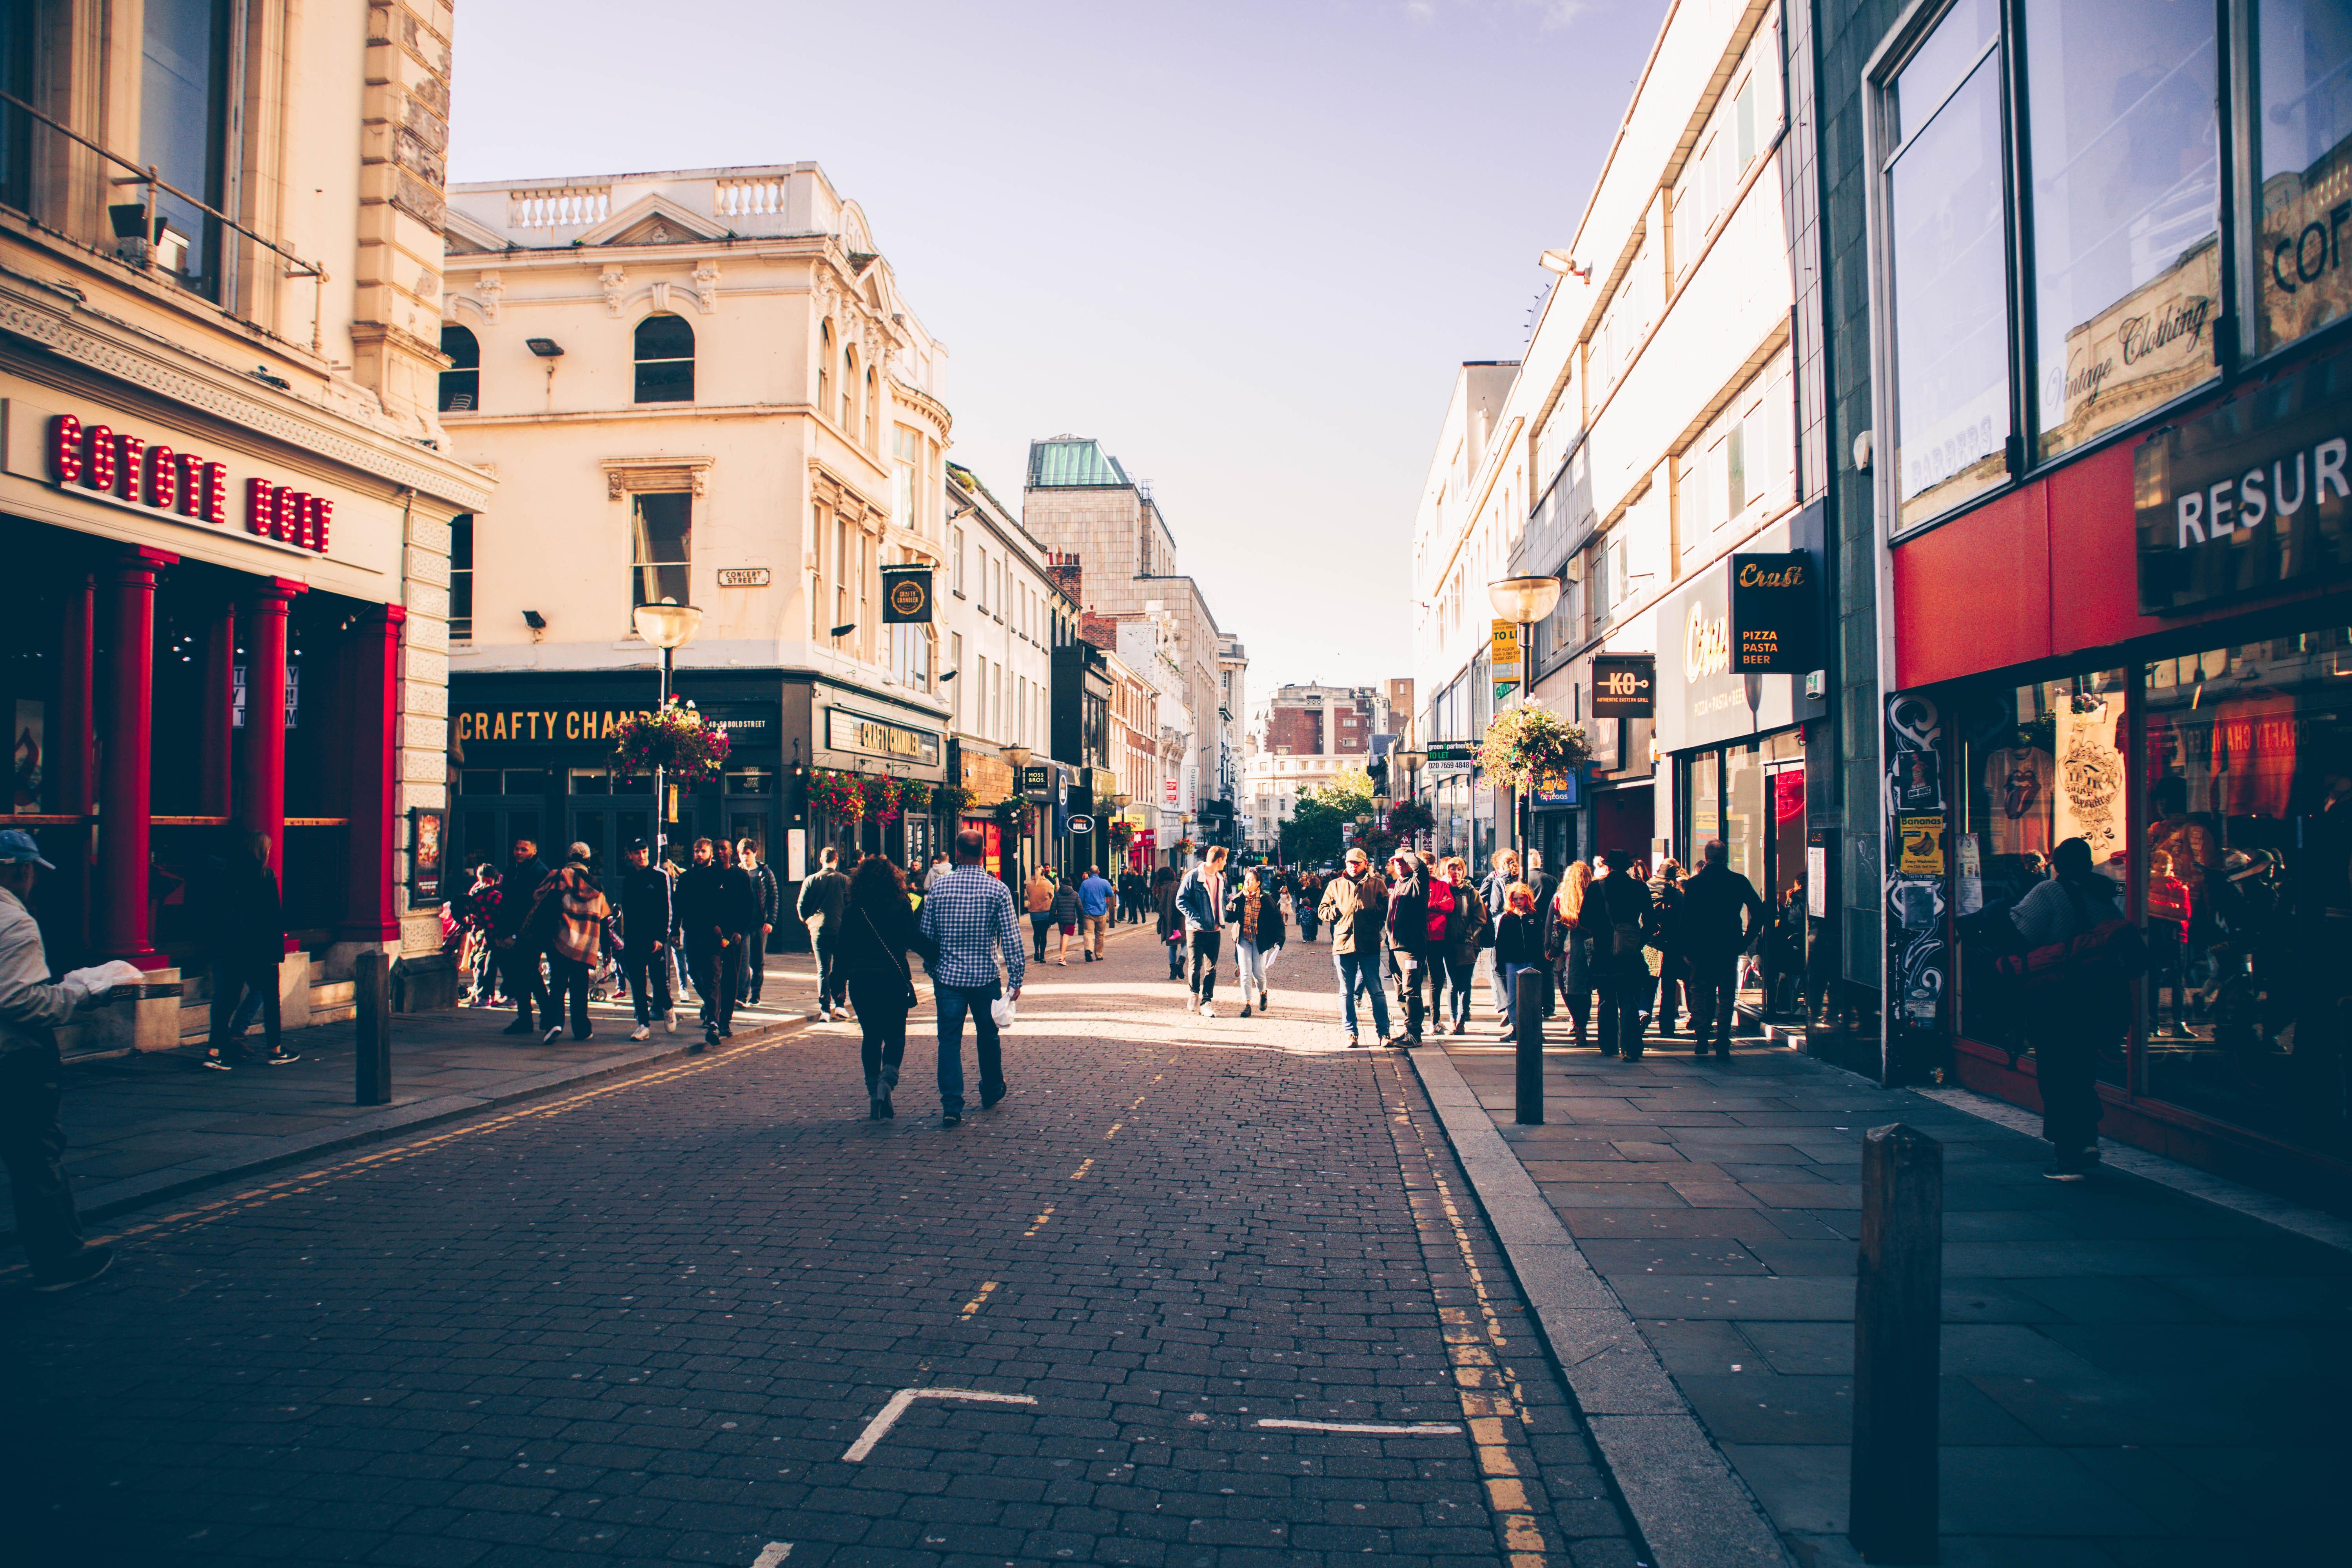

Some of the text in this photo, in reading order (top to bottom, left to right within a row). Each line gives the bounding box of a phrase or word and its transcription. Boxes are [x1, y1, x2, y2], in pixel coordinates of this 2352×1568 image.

[2046, 298, 2208, 410] Vintage Clothing
[49, 414, 333, 553] COYOTE UGLY
[2178, 437, 2351, 549] RESUR
[1740, 563, 1804, 587] Crust
[1494, 632, 1506, 640] TO
[1743, 631, 1777, 640] PIZZA
[1743, 643, 1778, 652] PASTA
[1743, 655, 1770, 664] BEER
[1610, 673, 1635, 695] KO
[1694, 687, 1746, 717] PIZZA PASTA BEER
[459, 711, 558, 740] CRAFTY
[862, 722, 918, 757] CRAFTY CHANDLER
[1779, 773, 1804, 785] ZZA
[1918, 787, 1930, 795] QUIZ
